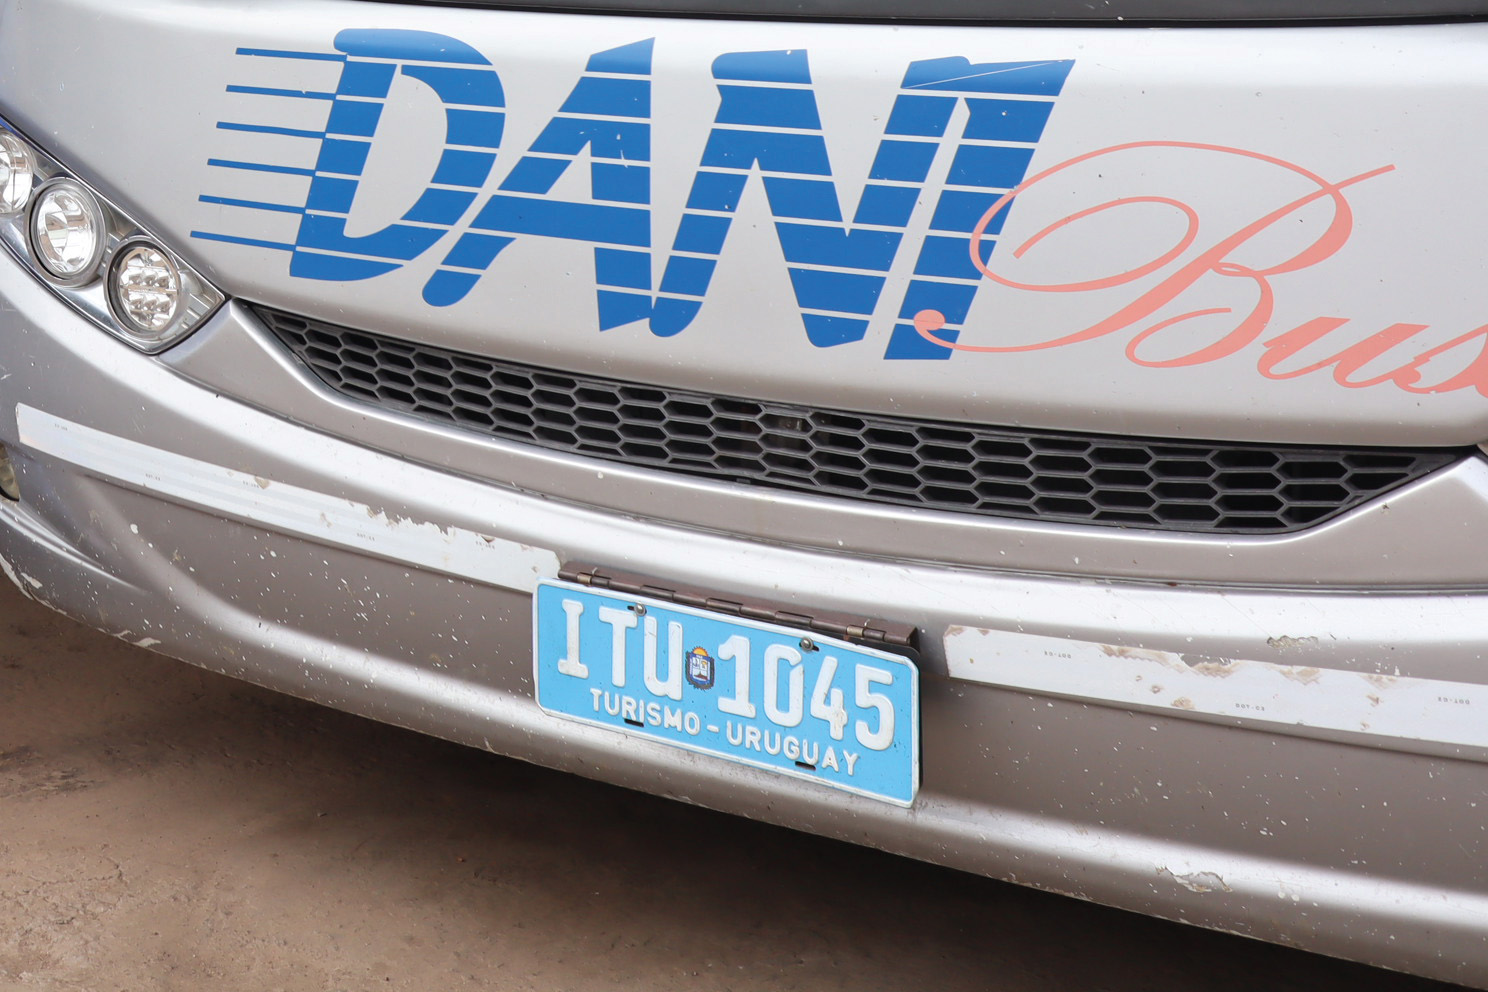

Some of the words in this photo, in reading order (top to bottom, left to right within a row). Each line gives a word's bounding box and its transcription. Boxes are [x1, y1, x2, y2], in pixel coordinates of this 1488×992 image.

[289, 27, 1076, 361] DANI
[914, 140, 1488, 399] Bus
[557, 598, 683, 702] ITU
[717, 634, 895, 752] 1045
[589, 688, 701, 737] TURISMO
[725, 721, 860, 777] URUGUAY
